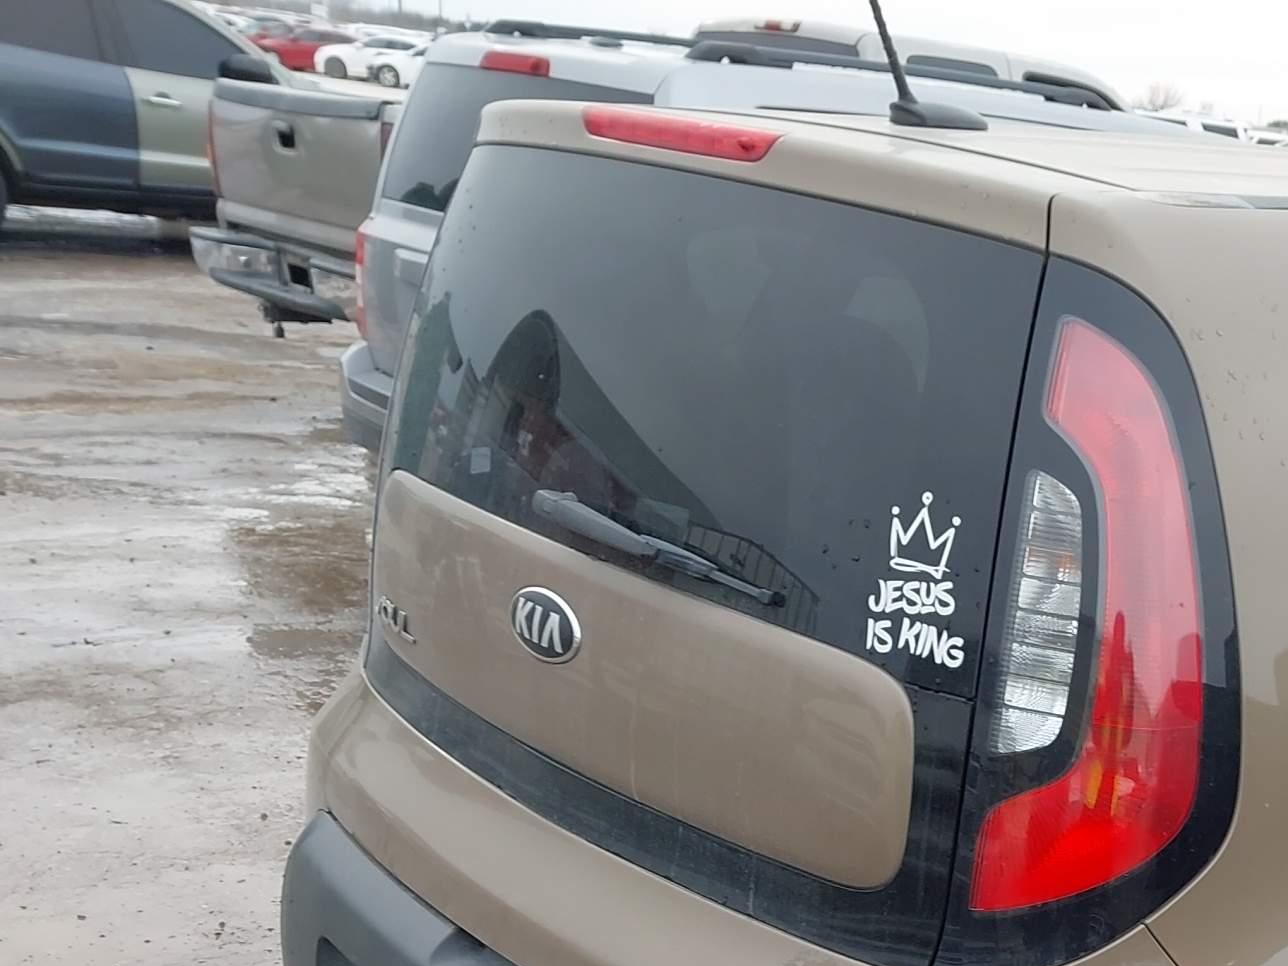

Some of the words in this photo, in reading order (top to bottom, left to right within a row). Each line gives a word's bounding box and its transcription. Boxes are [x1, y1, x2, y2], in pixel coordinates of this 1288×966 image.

[867, 579, 956, 616] JESUS
[514, 597, 564, 654] KIA
[866, 618, 893, 654] IS
[897, 617, 965, 669] KING
